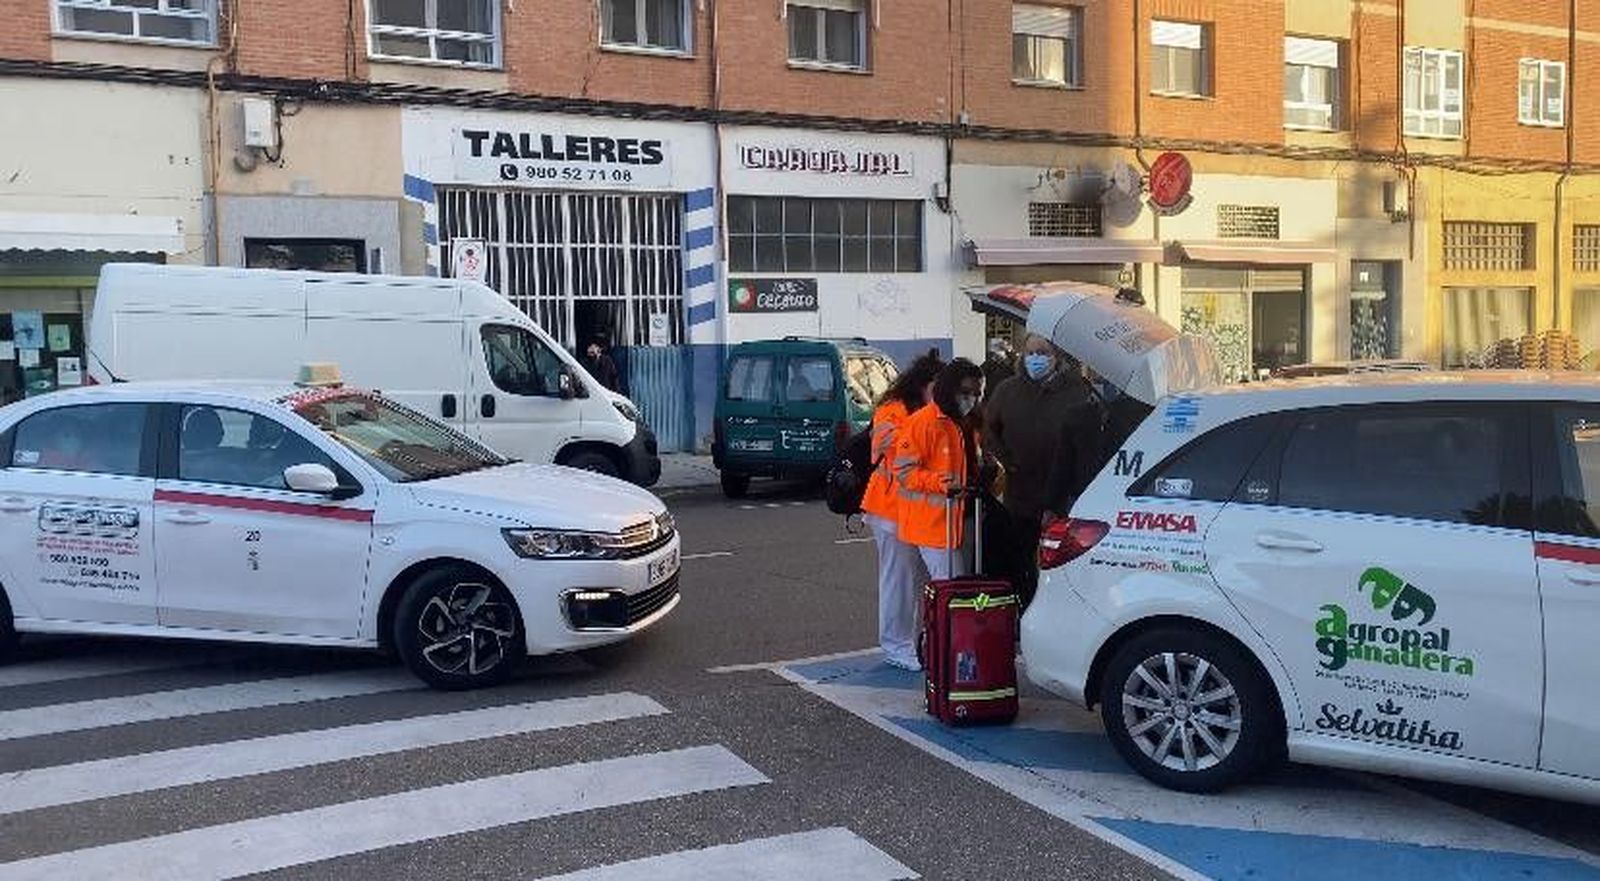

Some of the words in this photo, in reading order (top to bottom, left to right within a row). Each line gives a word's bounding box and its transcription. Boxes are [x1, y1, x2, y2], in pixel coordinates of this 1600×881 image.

[462, 129, 664, 165] TALLERES
[525, 165, 557, 179] 980
[561, 167, 582, 180] 52
[587, 169, 606, 180] 71
[611, 169, 632, 182] 08
[1114, 449, 1145, 477] M
[245, 530, 261, 541] 20
[1115, 511, 1197, 533] EMASA
[1315, 604, 1450, 652] agropal
[1315, 637, 1474, 676] ganadera
[1315, 703, 1464, 750] Selvatika
